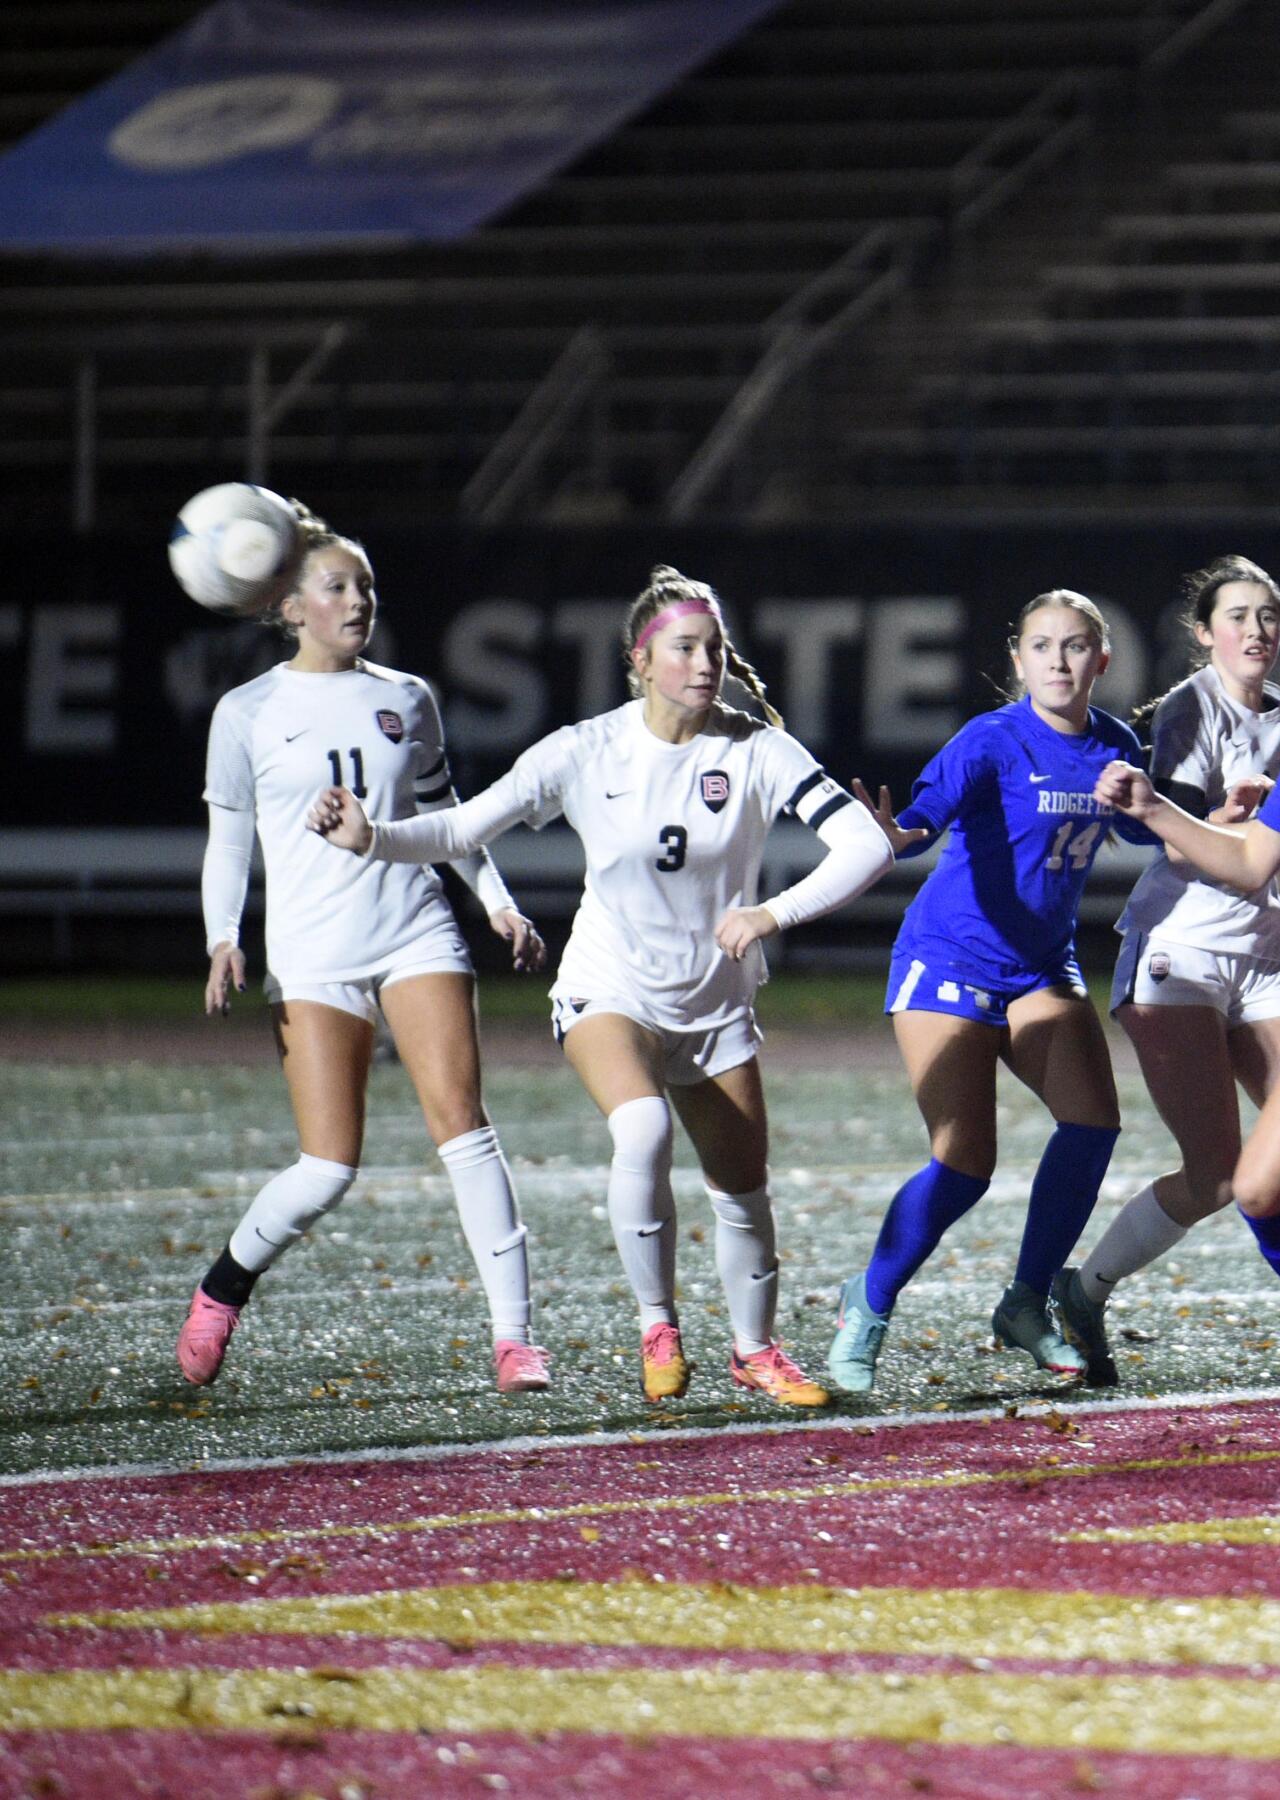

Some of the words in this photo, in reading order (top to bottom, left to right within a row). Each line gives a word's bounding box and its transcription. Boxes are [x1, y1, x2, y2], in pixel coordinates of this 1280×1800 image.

[440, 598, 968, 754] STTE
[328, 749, 367, 798] 11
[703, 775, 728, 800] B
[1037, 790, 1116, 816] RIDGEFI
[656, 825, 688, 872] 3
[1045, 821, 1100, 869] 14
